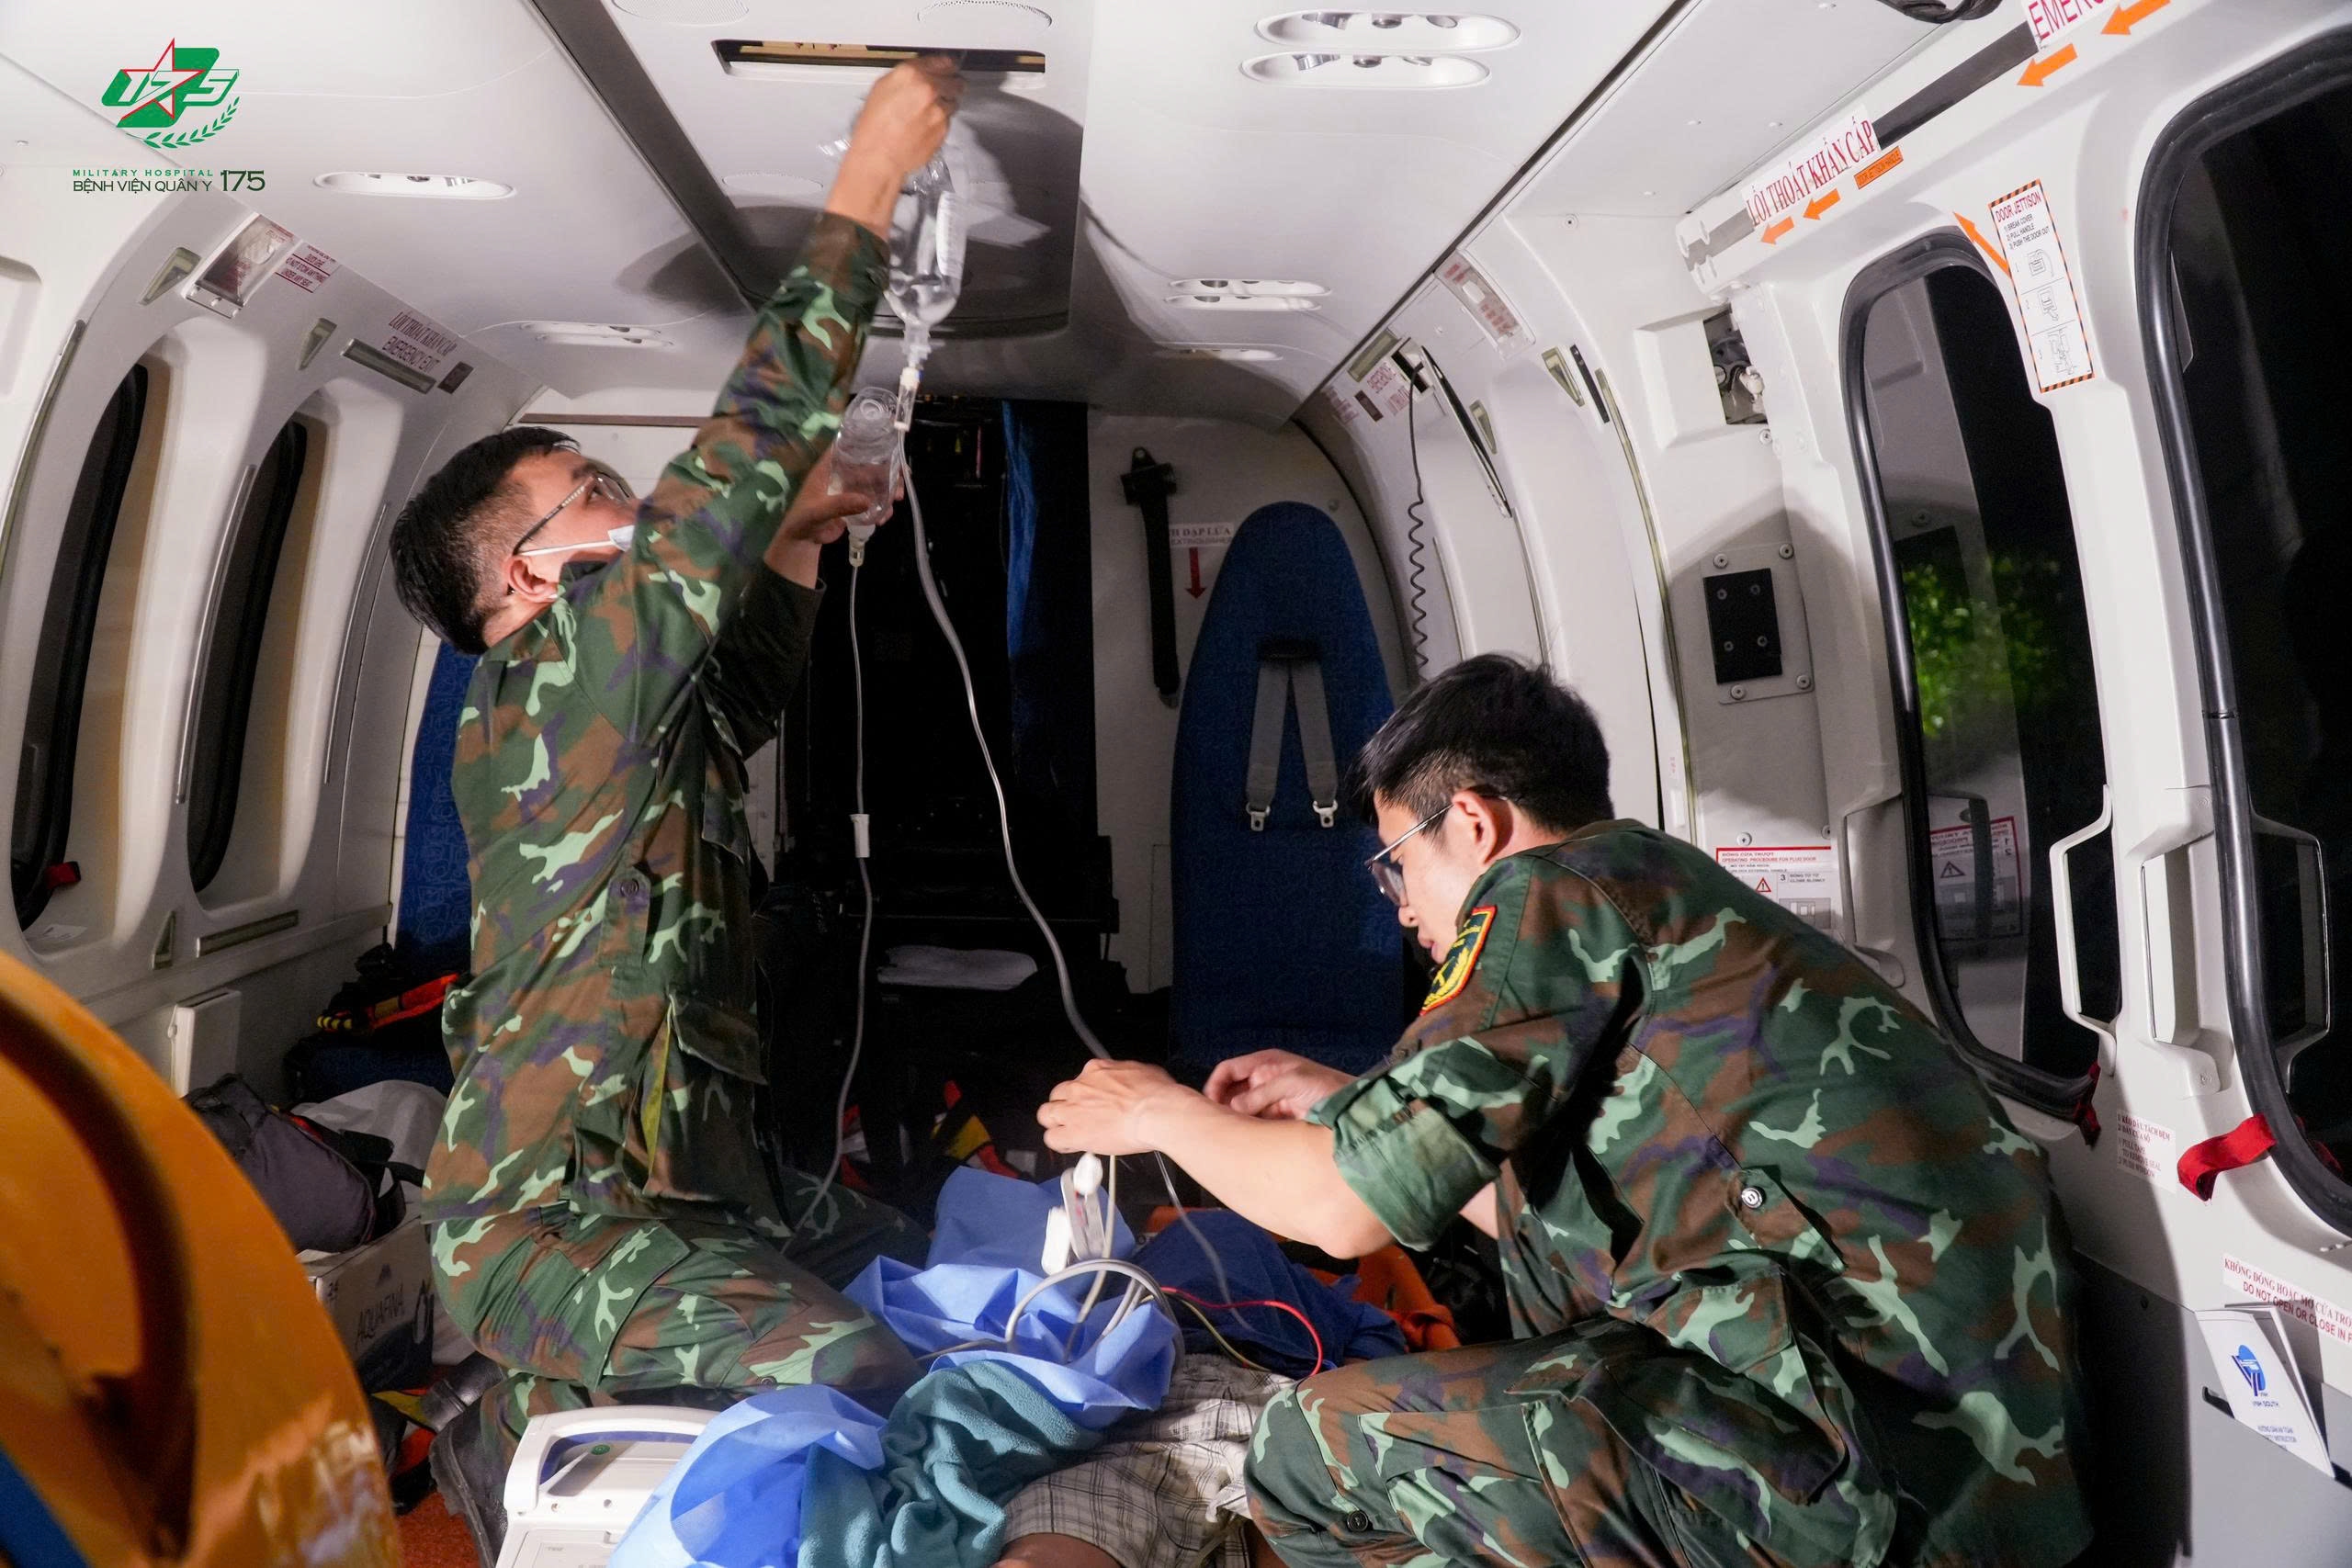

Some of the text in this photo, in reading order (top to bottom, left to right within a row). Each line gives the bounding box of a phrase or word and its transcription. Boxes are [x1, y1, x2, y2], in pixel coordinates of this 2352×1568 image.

[2029, 0, 2104, 40] EME
[1746, 115, 1875, 226] LỐI THOÁT KHẨN CẤP
[1996, 191, 2041, 222] DOOR JETTISON
[2007, 220, 2019, 231] BREAK
[2019, 214, 2033, 227] COVER
[2020, 222, 2035, 237] HANDLE
[2022, 234, 2031, 244] THE
[2030, 230, 2041, 242] DOOR
[2041, 225, 2050, 236] OUT
[1781, 874, 1786, 882] 3
[2224, 1258, 2251, 1280] KHÔNG
[356, 1284, 404, 1345] AQUAFINA
[2243, 1281, 2255, 1294] DO
[2256, 1288, 2271, 1304] NOT
[2272, 1296, 2294, 1314] OPEN
[2295, 1307, 2307, 1322] OR
[2309, 1314, 2335, 1337] CLOSE
[2337, 1327, 2346, 1340] IN
